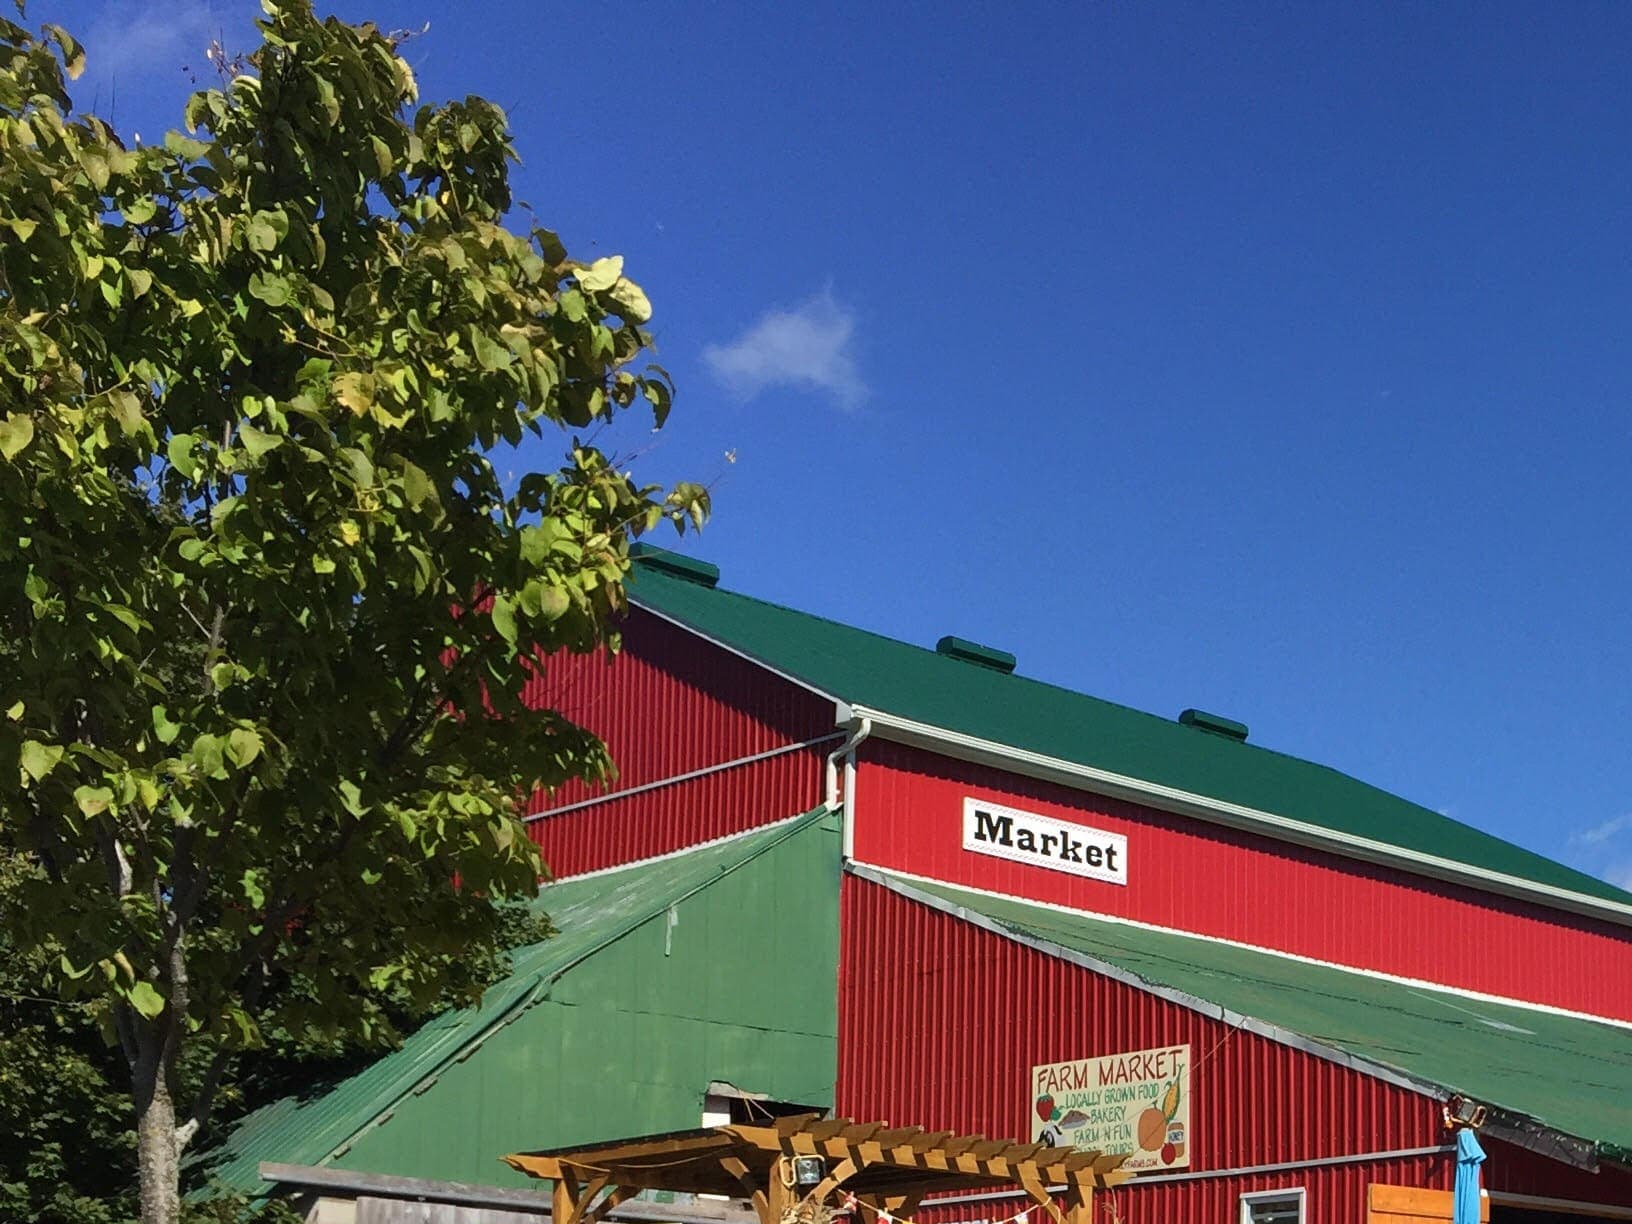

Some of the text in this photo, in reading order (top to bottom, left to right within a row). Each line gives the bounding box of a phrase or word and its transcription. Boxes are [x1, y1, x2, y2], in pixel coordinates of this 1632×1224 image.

[974, 809, 1119, 872] Market
[1037, 1050, 1183, 1095] FARM MARKET
[1065, 1083, 1159, 1109] LOCALLY GROWN FOOD
[1090, 1106, 1126, 1124] BAKERY
[1074, 1127, 1099, 1145] FARM
[1114, 1124, 1132, 1141] FUN
